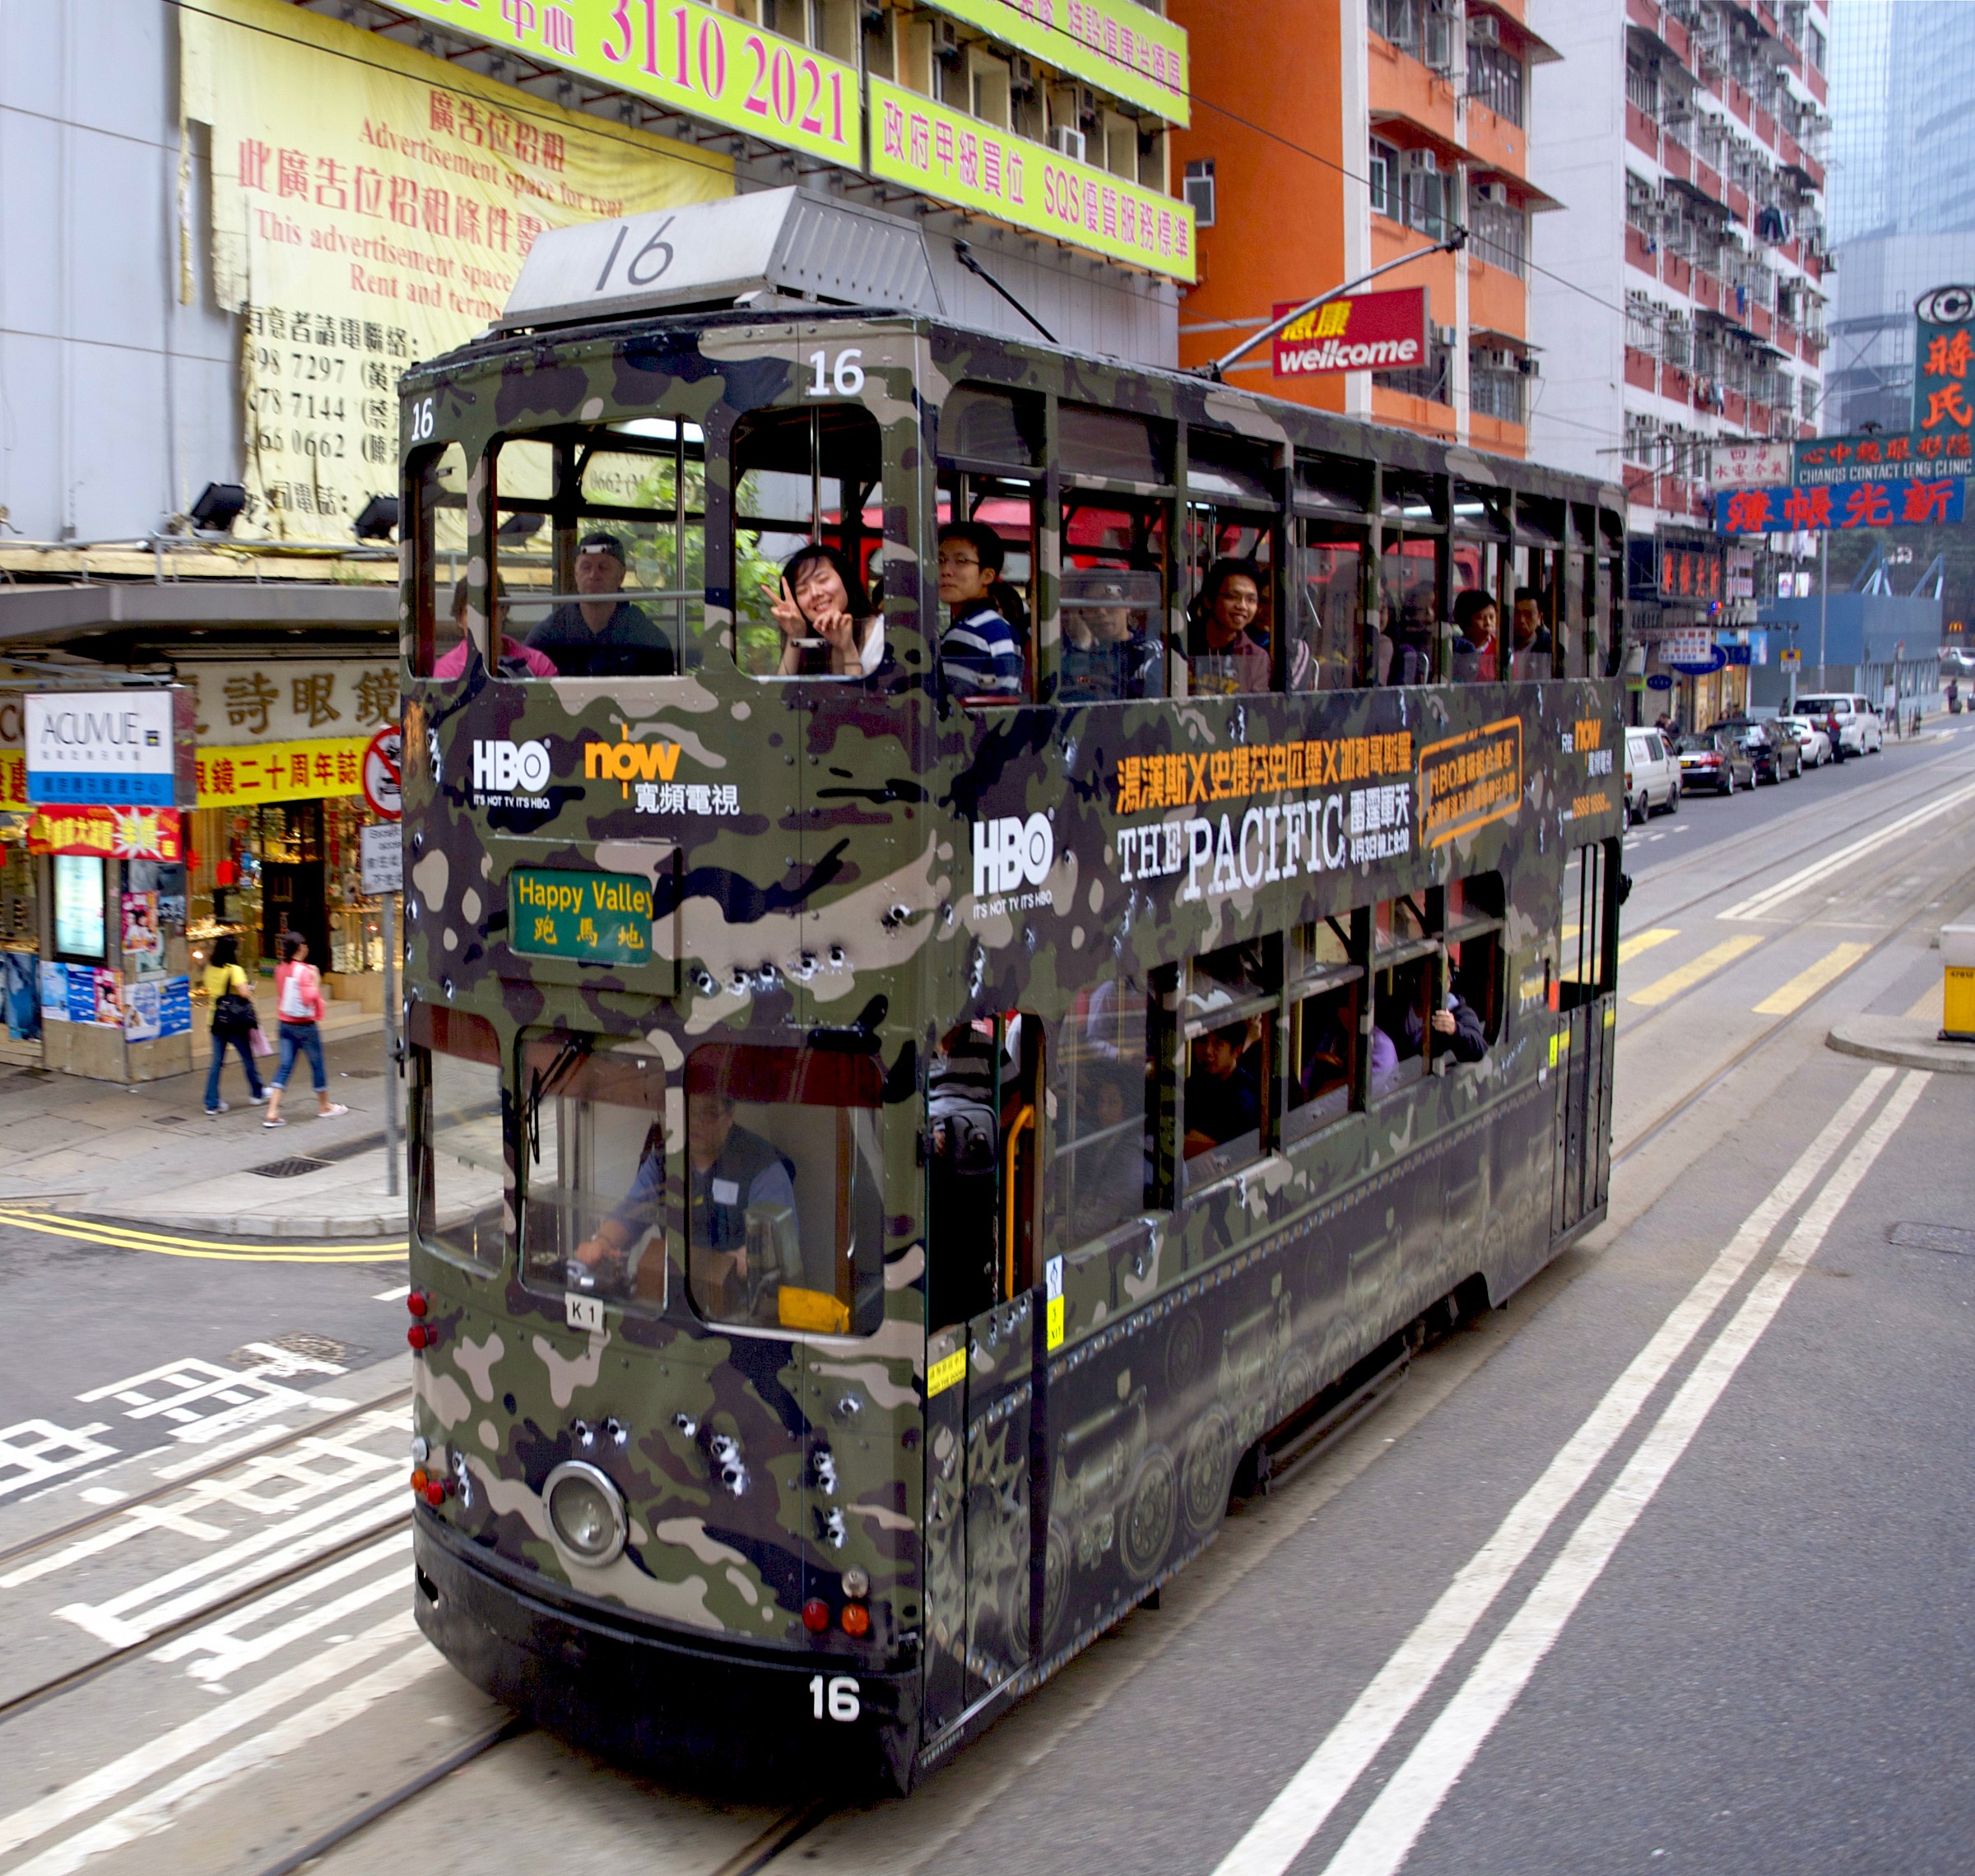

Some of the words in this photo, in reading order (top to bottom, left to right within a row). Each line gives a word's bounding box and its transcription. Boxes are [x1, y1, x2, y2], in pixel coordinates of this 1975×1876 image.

[602, 0, 727, 101] 3110
[742, 35, 849, 146] 2021
[428, 89, 565, 173] 廣告位招租
[882, 99, 1025, 206] 政府甲級買位
[358, 116, 499, 184] Advertisement
[504, 169, 555, 199] space
[560, 181, 586, 209] for
[589, 196, 625, 217] rent
[237, 136, 553, 257] 此廣告位招租條件靈
[253, 207, 302, 247] This
[309, 224, 455, 280] advertisement
[460, 262, 512, 295] space
[596, 216, 676, 292] 16
[350, 262, 398, 299] Rent
[406, 281, 442, 309] and
[448, 290, 503, 320] terms
[250, 346, 281, 376] 98
[290, 352, 346, 383] 7297
[808, 348, 866, 397] 16
[1280, 339, 1419, 374] wellcome
[290, 392, 346, 421] 7144
[411, 397, 434, 442] 16
[290, 428, 346, 459] 0662
[1799, 466, 1846, 485] CHIANGS
[1849, 463, 1900, 482] CONTACT
[1903, 461, 1932, 478] LENS
[1935, 458, 1973, 476] CLINIC
[41, 711, 141, 745] ACUVUE
[1575, 717, 1601, 752] now
[473, 739, 551, 792] HBO
[585, 732, 681, 788] now
[487, 795, 503, 807] NOT
[634, 782, 740, 815] 寬頻電視
[974, 811, 1053, 897] HBO
[1117, 820, 1182, 884] THE
[1183, 793, 1343, 902] PACIFIC
[519, 875, 583, 915] Happy
[592, 880, 653, 920] Valley
[990, 902, 1006, 917] NOT
[534, 914, 644, 950] 跑馬地
[809, 1674, 861, 1722] 16
